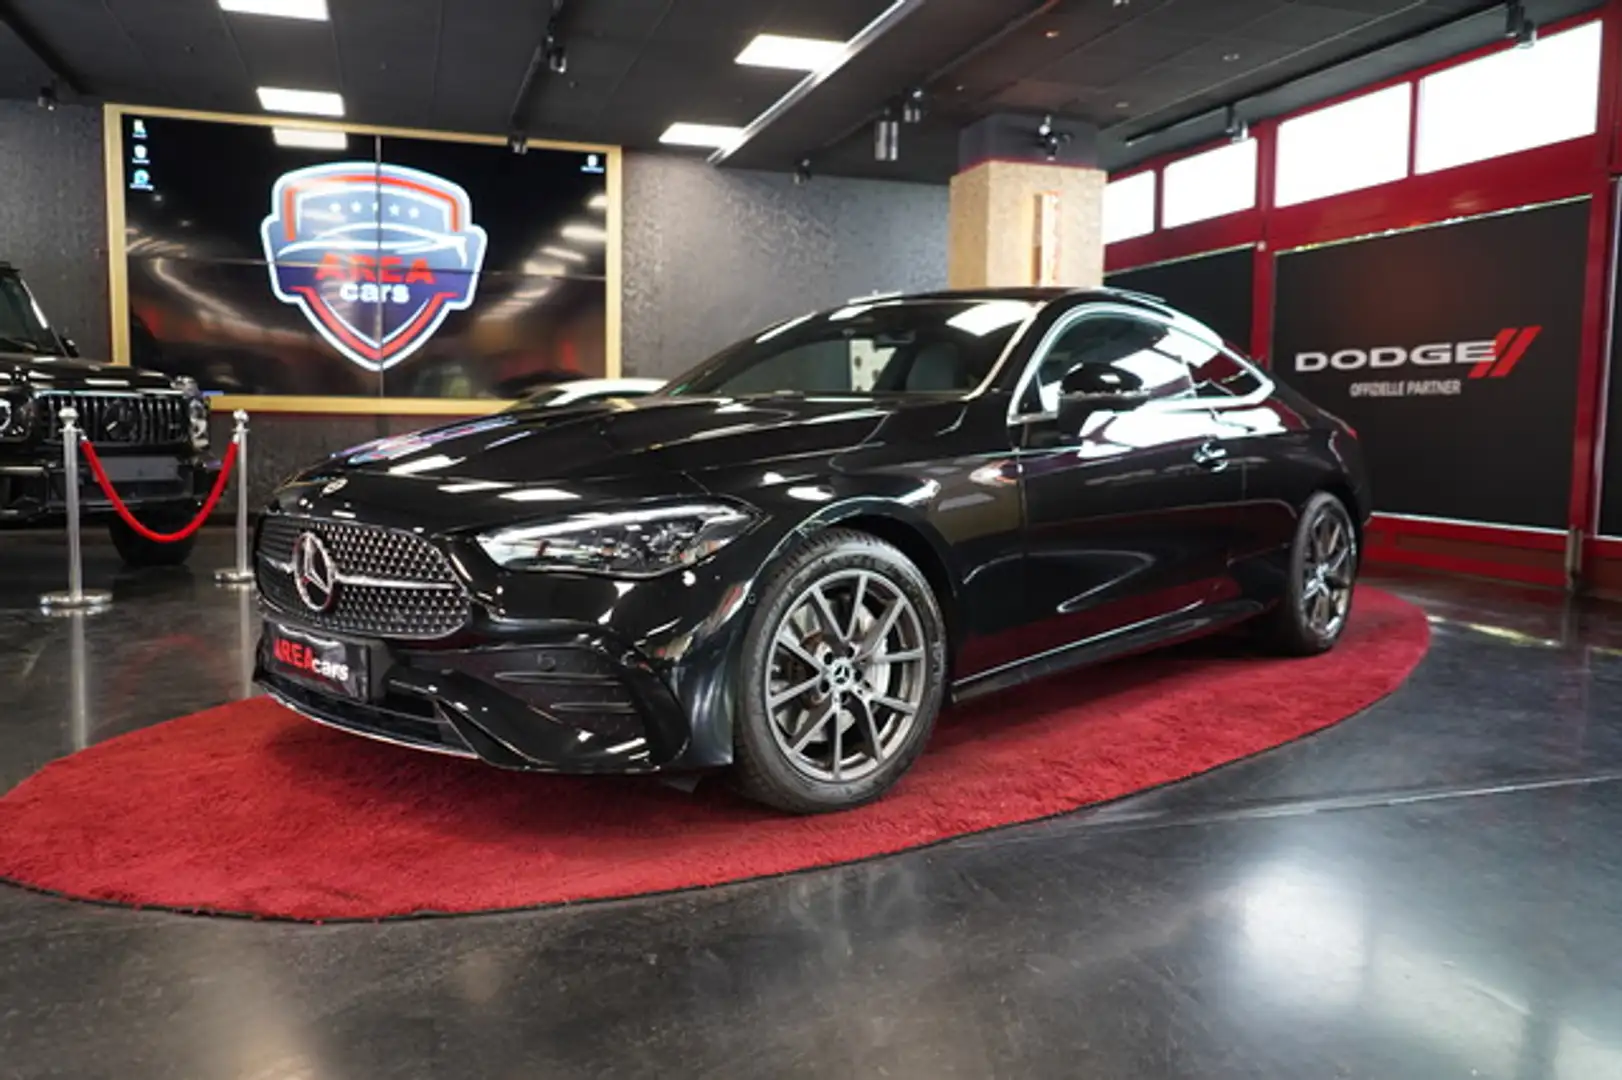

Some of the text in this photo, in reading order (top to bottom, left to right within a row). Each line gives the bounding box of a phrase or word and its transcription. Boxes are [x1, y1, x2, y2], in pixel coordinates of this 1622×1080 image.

[315, 252, 436, 284] AREA
[339, 283, 410, 304] cars
[1295, 340, 1497, 371] DODGE
[1350, 379, 1461, 397] OFFIZIELLE PARTNER
